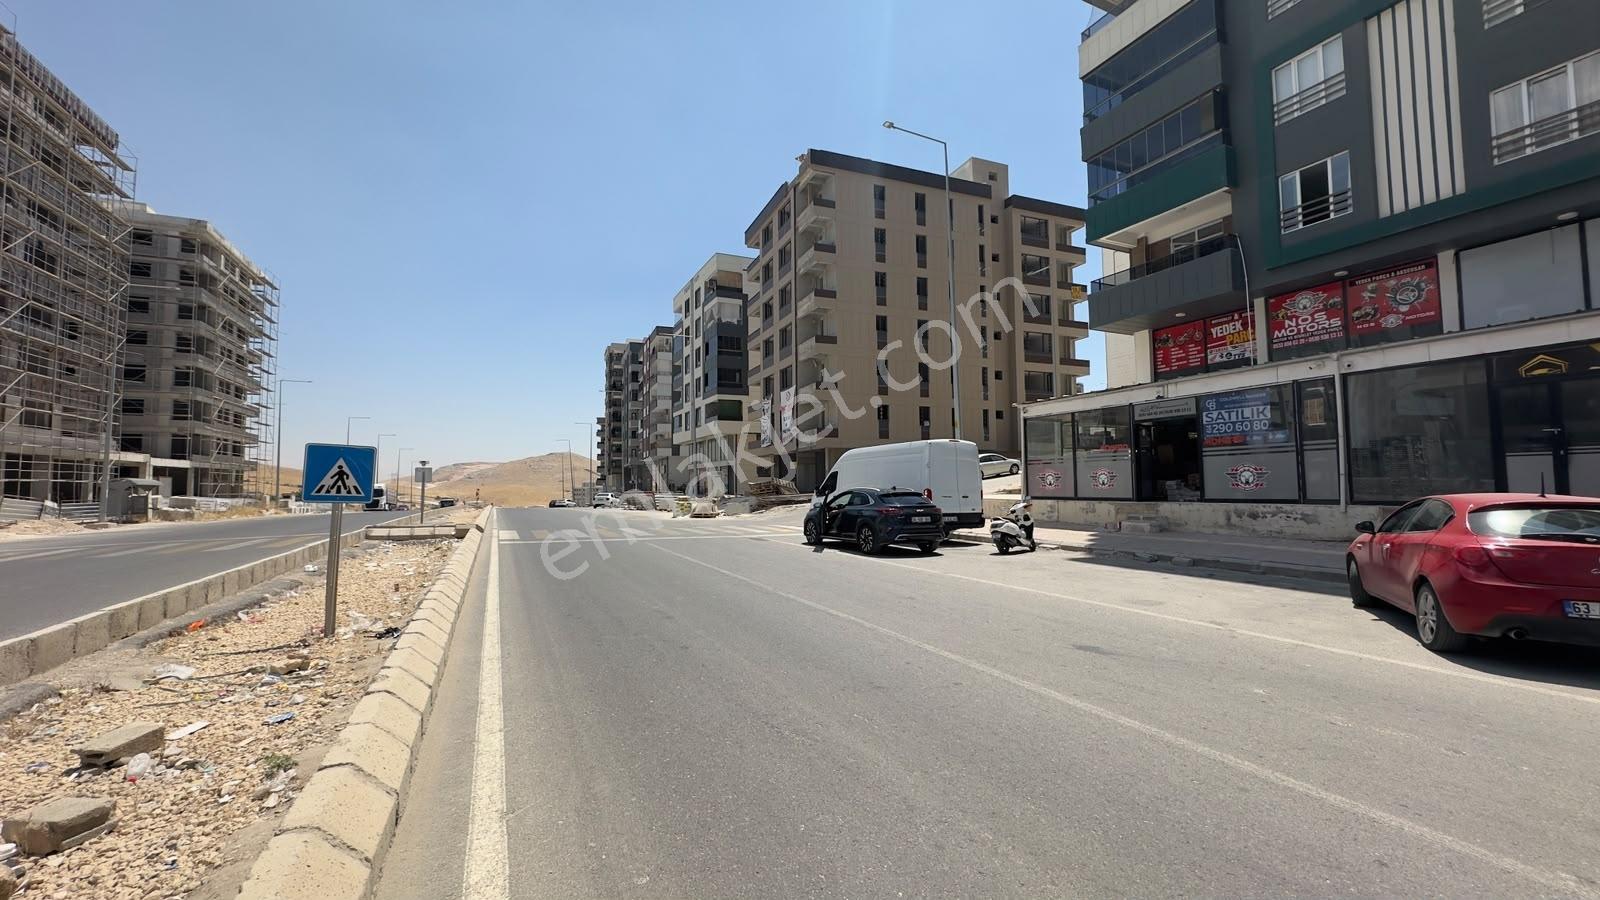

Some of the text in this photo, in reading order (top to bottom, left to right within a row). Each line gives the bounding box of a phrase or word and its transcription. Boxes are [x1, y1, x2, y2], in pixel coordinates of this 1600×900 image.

[1273, 318, 1342, 338] MOTORS
[1285, 312, 1327, 328] NOS
[1211, 320, 1243, 338] YEDEK
[1205, 406, 1269, 423] SATILIK
[1212, 423, 1233, 433] 290
[1235, 421, 1250, 431] 60
[1253, 420, 1269, 430] 80
[1573, 602, 1590, 614] 63
